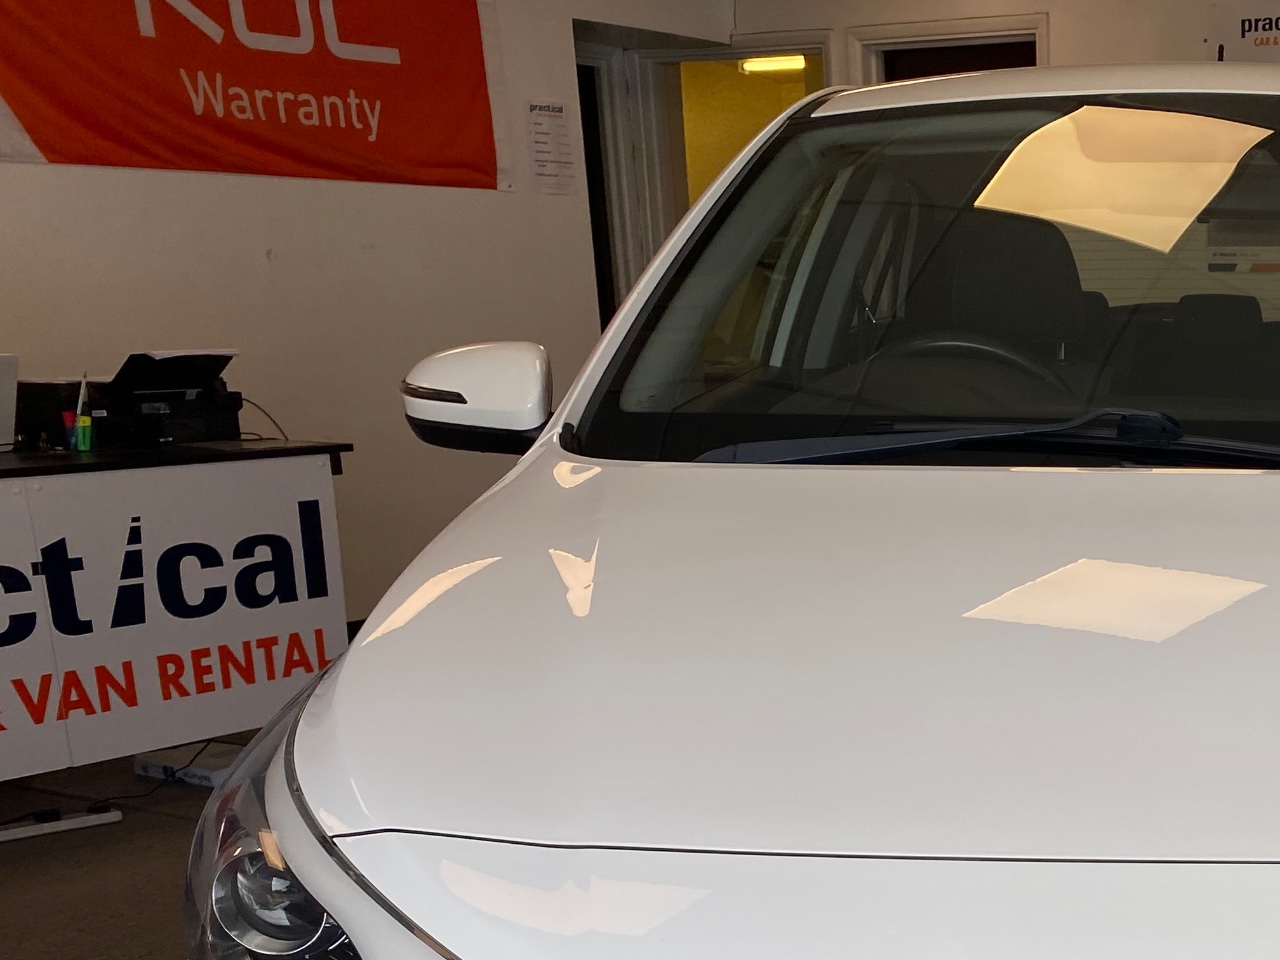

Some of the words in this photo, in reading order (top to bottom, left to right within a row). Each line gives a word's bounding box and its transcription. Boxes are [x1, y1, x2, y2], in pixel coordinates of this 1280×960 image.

[1254, 36, 1271, 47] CAR
[1273, 36, 1279, 46] &
[178, 68, 381, 142] Warranty
[11, 660, 139, 725] VAN
[156, 628, 334, 701] RENTAL
